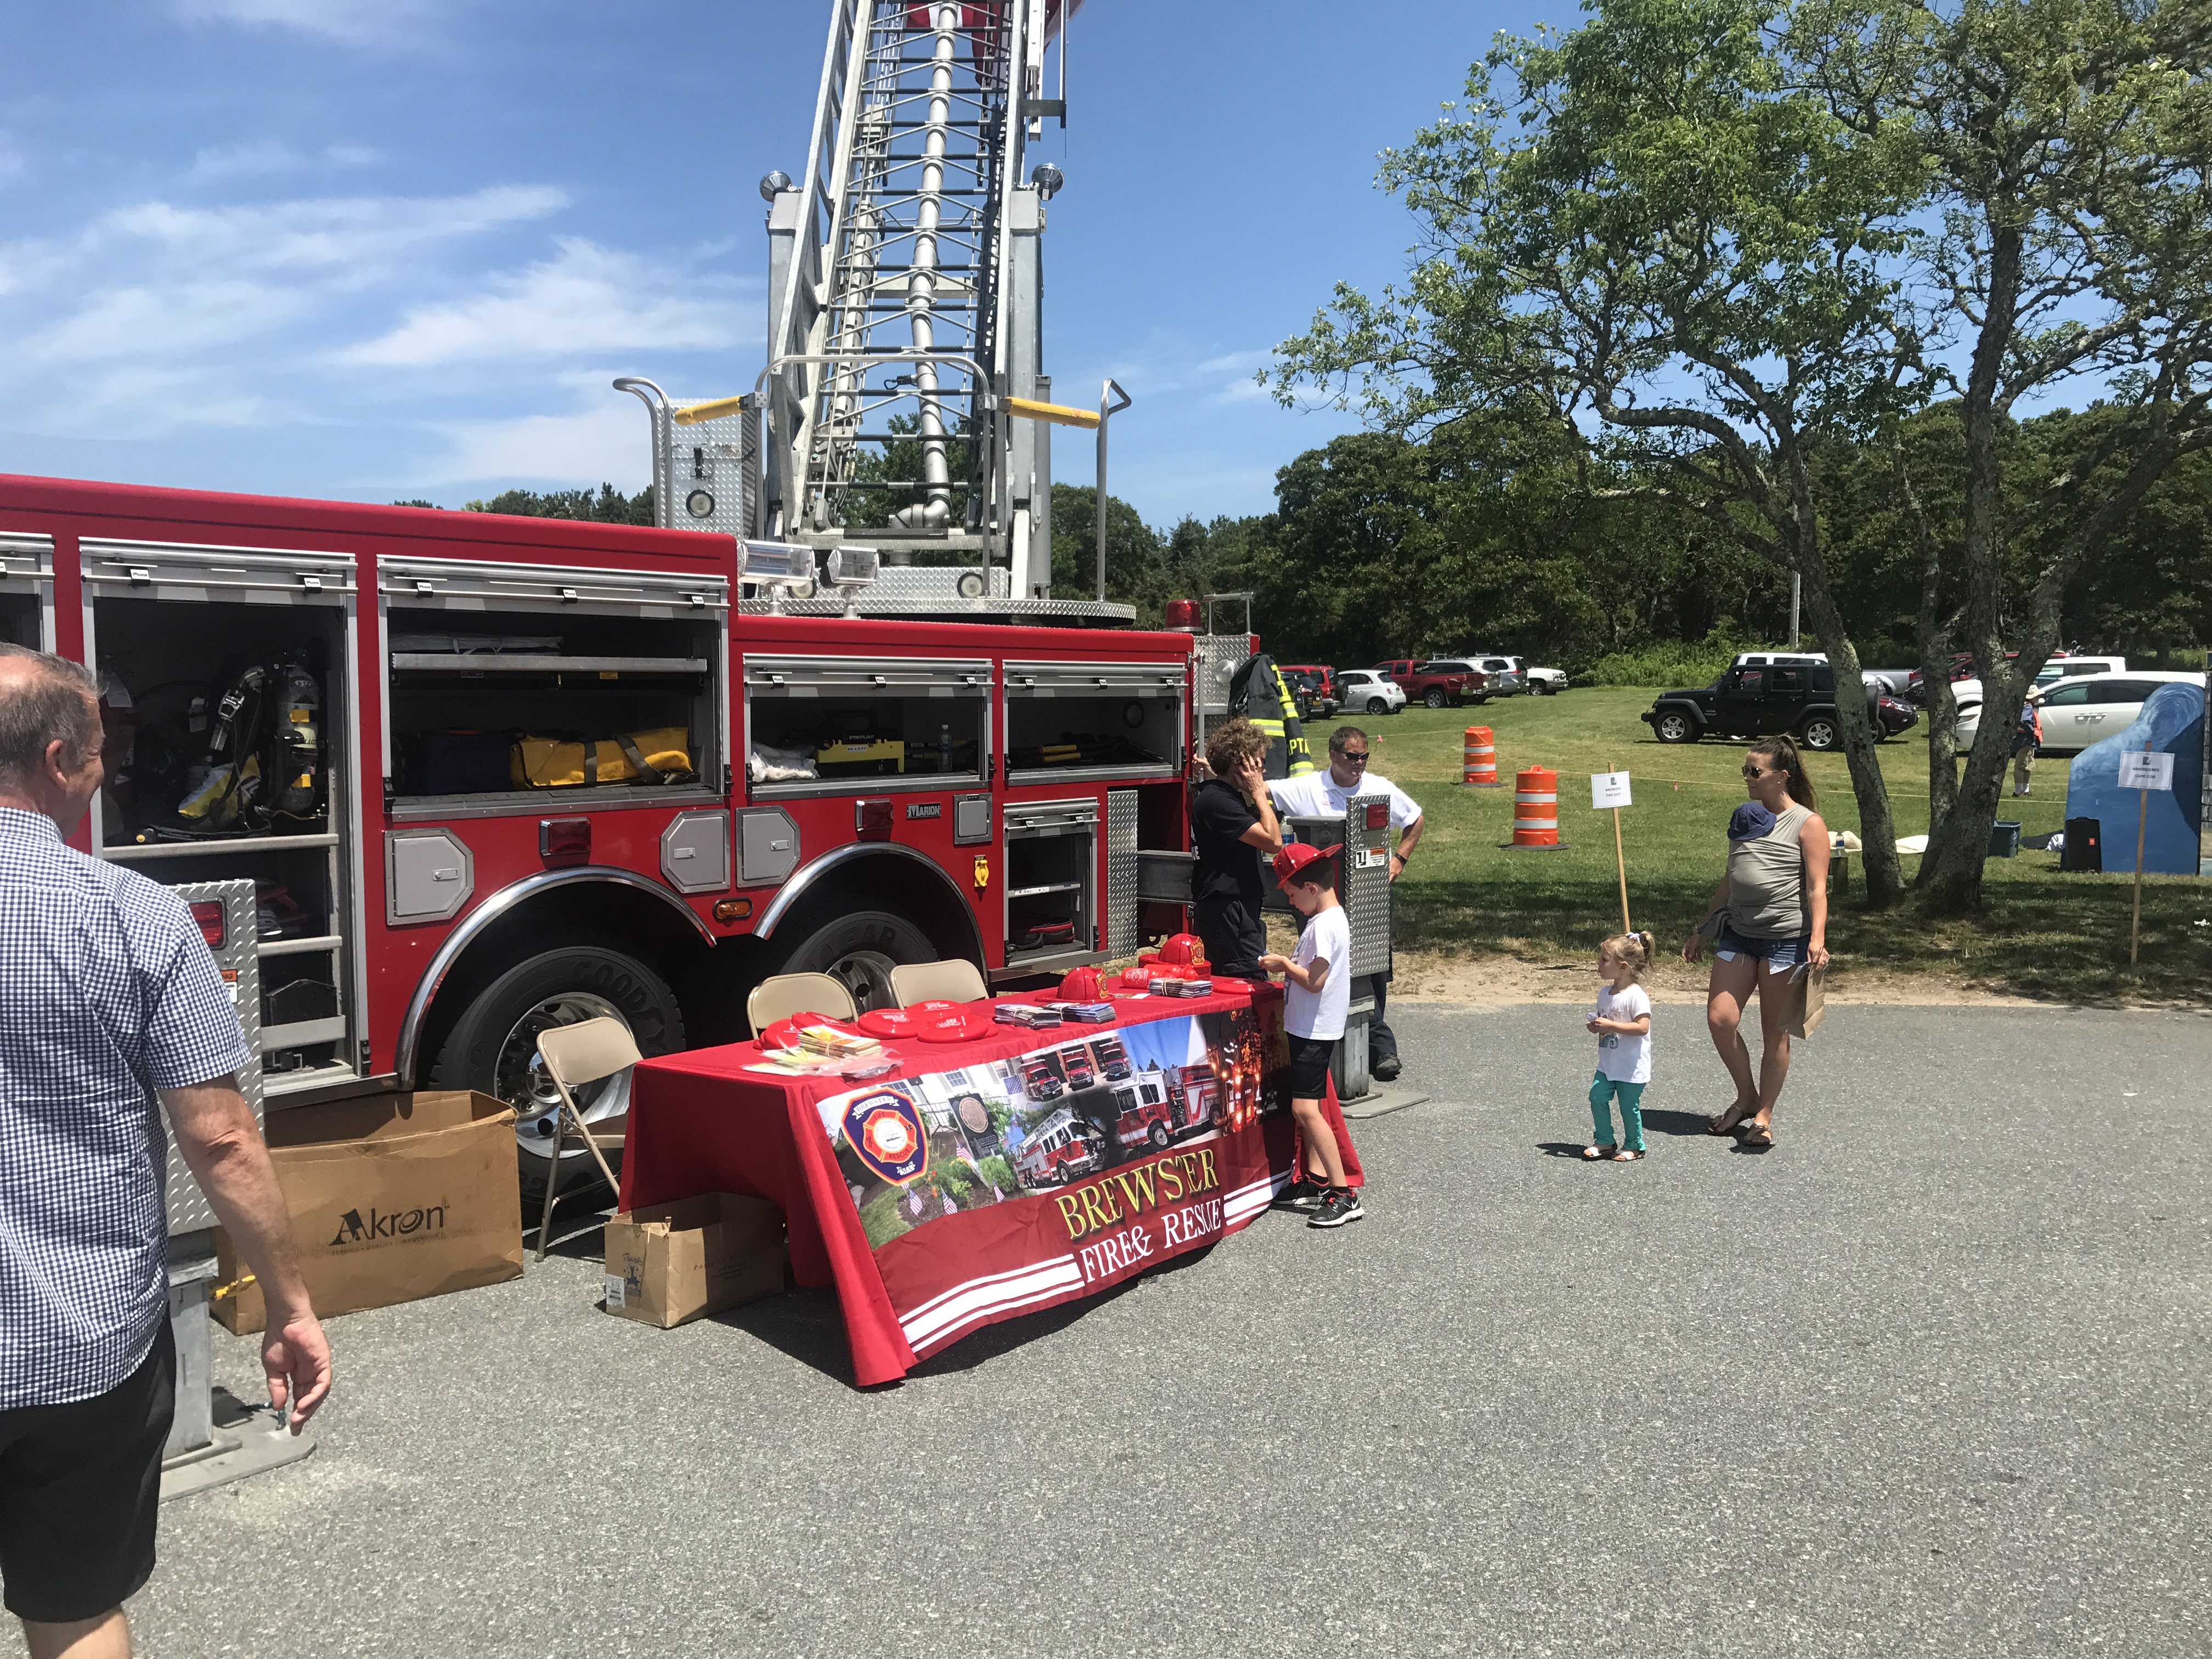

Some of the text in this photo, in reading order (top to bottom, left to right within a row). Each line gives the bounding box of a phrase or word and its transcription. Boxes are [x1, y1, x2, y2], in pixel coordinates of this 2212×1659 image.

[908, 805, 941, 817] MARION
[856, 1097, 892, 1112] BREWSTER
[873, 1112, 885, 1120] FIRE
[889, 1148, 911, 1159] RESCUE
[902, 1167, 913, 1175] MA
[1055, 1149, 1220, 1240] BREWSER
[329, 1206, 444, 1246] Akron
